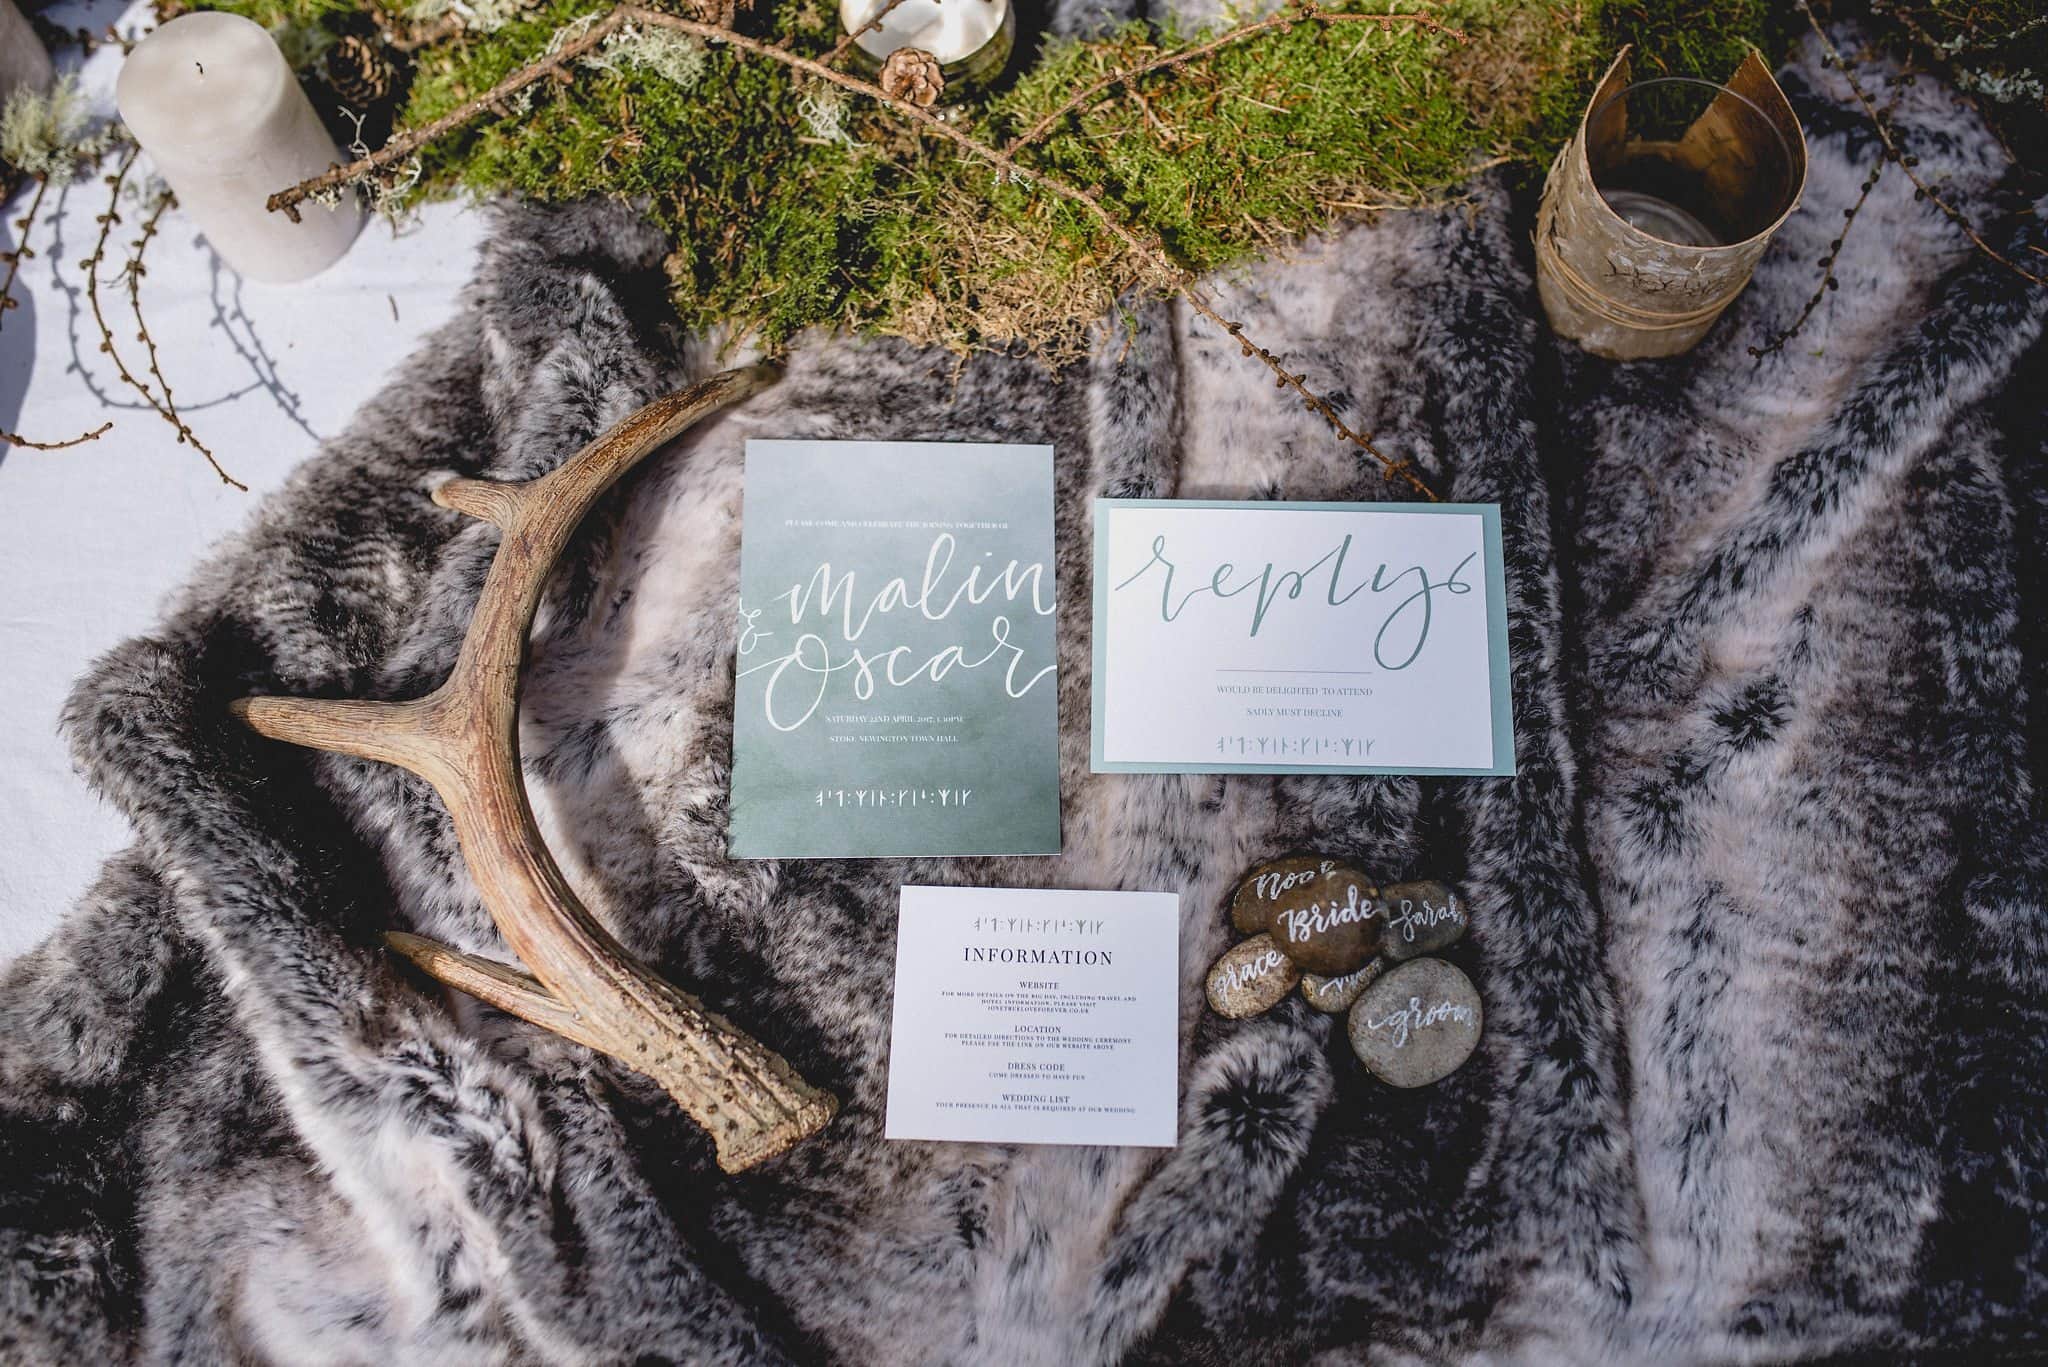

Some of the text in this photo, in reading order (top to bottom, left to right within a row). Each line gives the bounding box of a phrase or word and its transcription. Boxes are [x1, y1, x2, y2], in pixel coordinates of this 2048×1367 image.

[1115, 533, 1476, 671] reply
[737, 616, 1057, 732] Oscar
[1216, 686, 1373, 697] WOULD BE DELIGHTED TO ATTEND
[1246, 708, 1344, 718] SADLY MUST DECLINE
[825, 715, 866, 724] SATURDAY
[892, 715, 913, 723] APRIL
[830, 735, 959, 743] STOKE NEWINGTON TOWN HALL
[1276, 884, 1384, 943] Bride
[1389, 893, 1466, 943] Sarah
[963, 947, 1113, 966] INFORMATION
[1019, 981, 1060, 990] WEBSITE
[1367, 996, 1475, 1049] groom
[1014, 1025, 1062, 1033] LOCATION
[1007, 1062, 1065, 1071] DRESS CODE
[1002, 1094, 1071, 1104] WEDDING LIST
